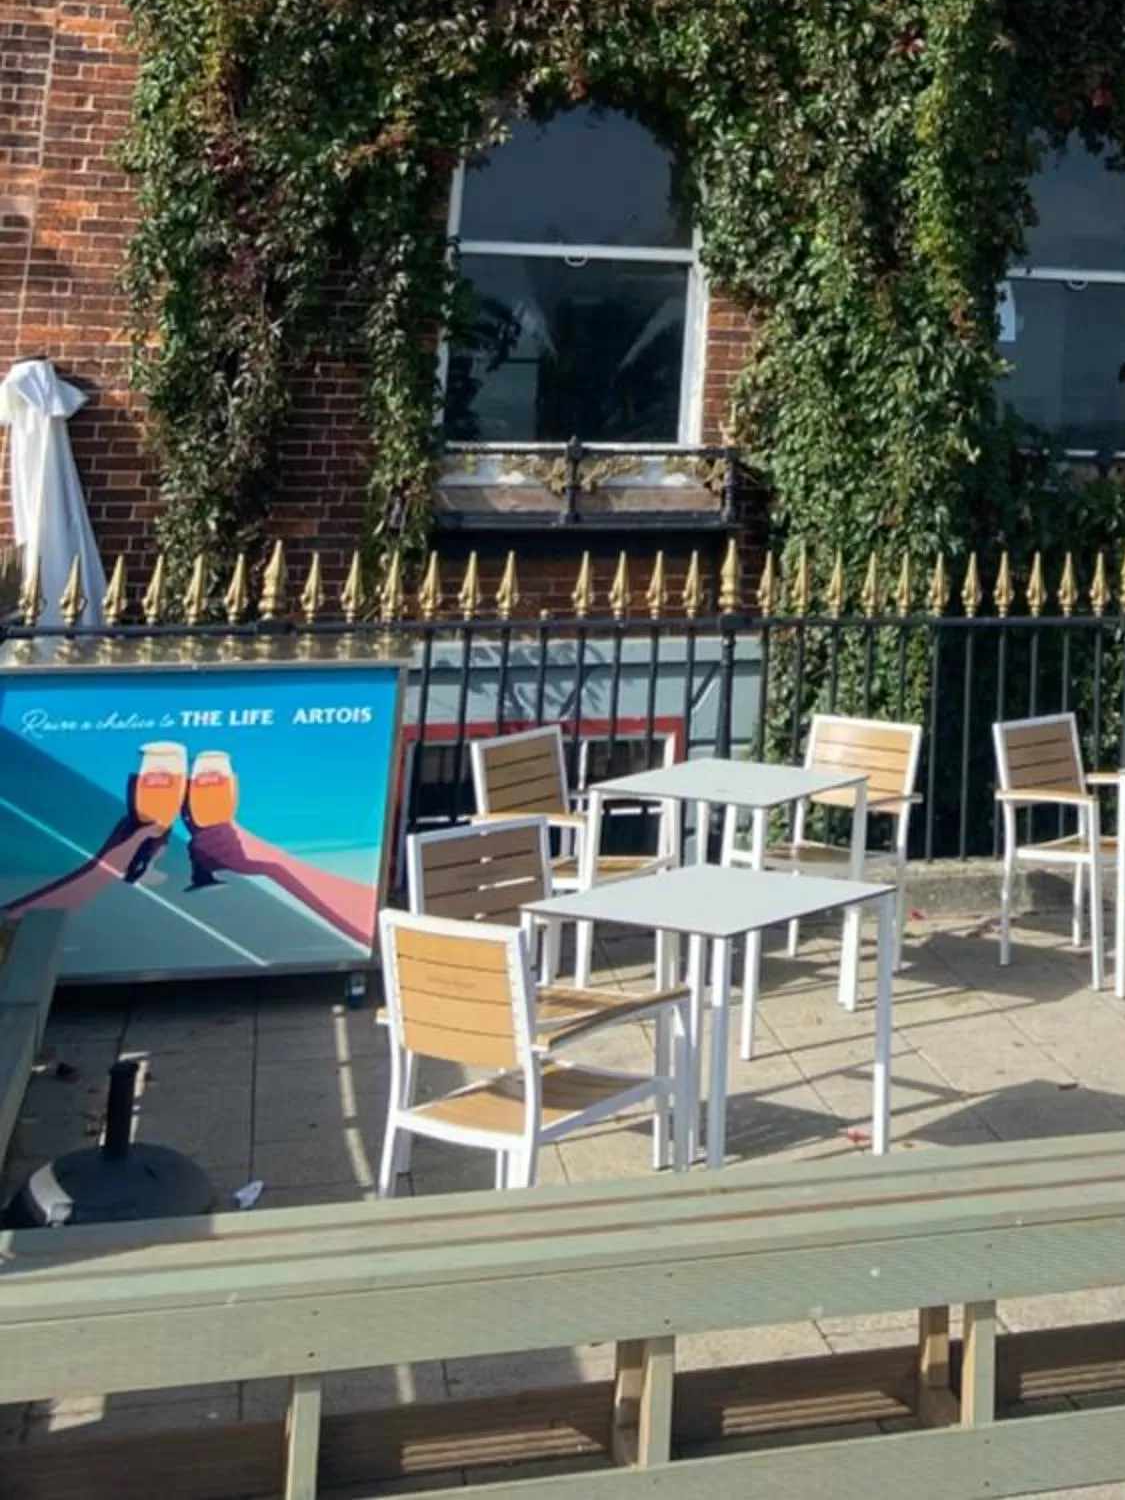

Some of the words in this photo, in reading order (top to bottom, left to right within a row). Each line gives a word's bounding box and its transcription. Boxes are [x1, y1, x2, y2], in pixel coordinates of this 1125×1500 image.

[180, 710, 223, 727] THE
[229, 709, 274, 726] LIFE
[292, 707, 373, 725] ARTOIS
